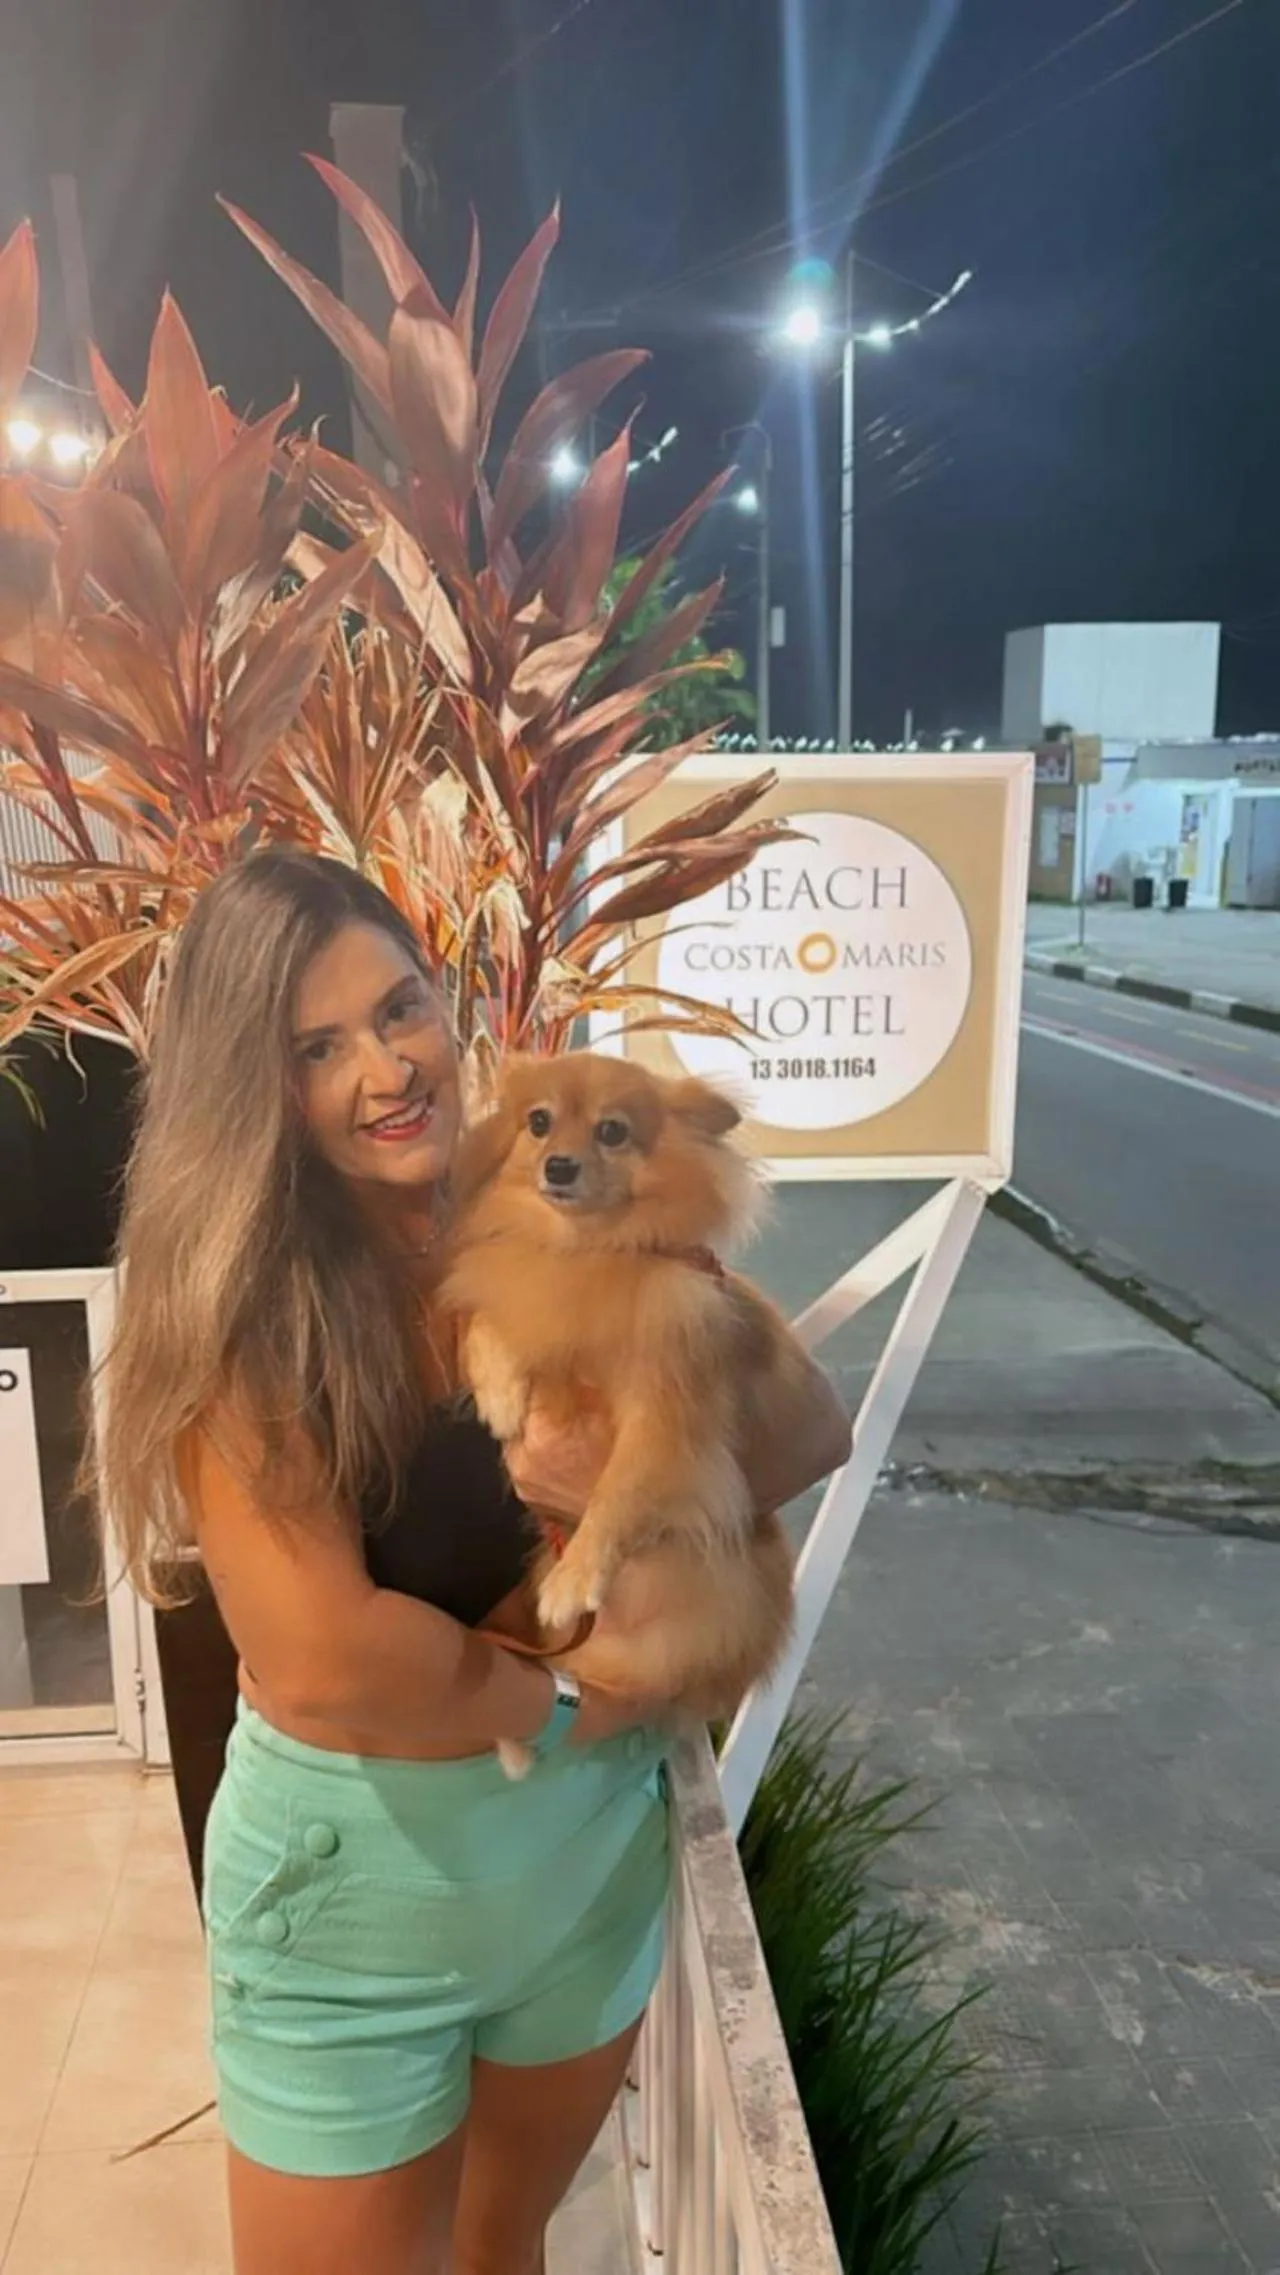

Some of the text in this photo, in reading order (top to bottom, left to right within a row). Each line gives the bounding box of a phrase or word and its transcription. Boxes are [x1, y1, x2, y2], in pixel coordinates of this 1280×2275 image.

[726, 866, 909, 912] BEACH
[683, 941, 947, 971] COSTA MARIS
[725, 995, 906, 1039] HOTEL
[750, 1058, 876, 1080] 13 3018.1164
